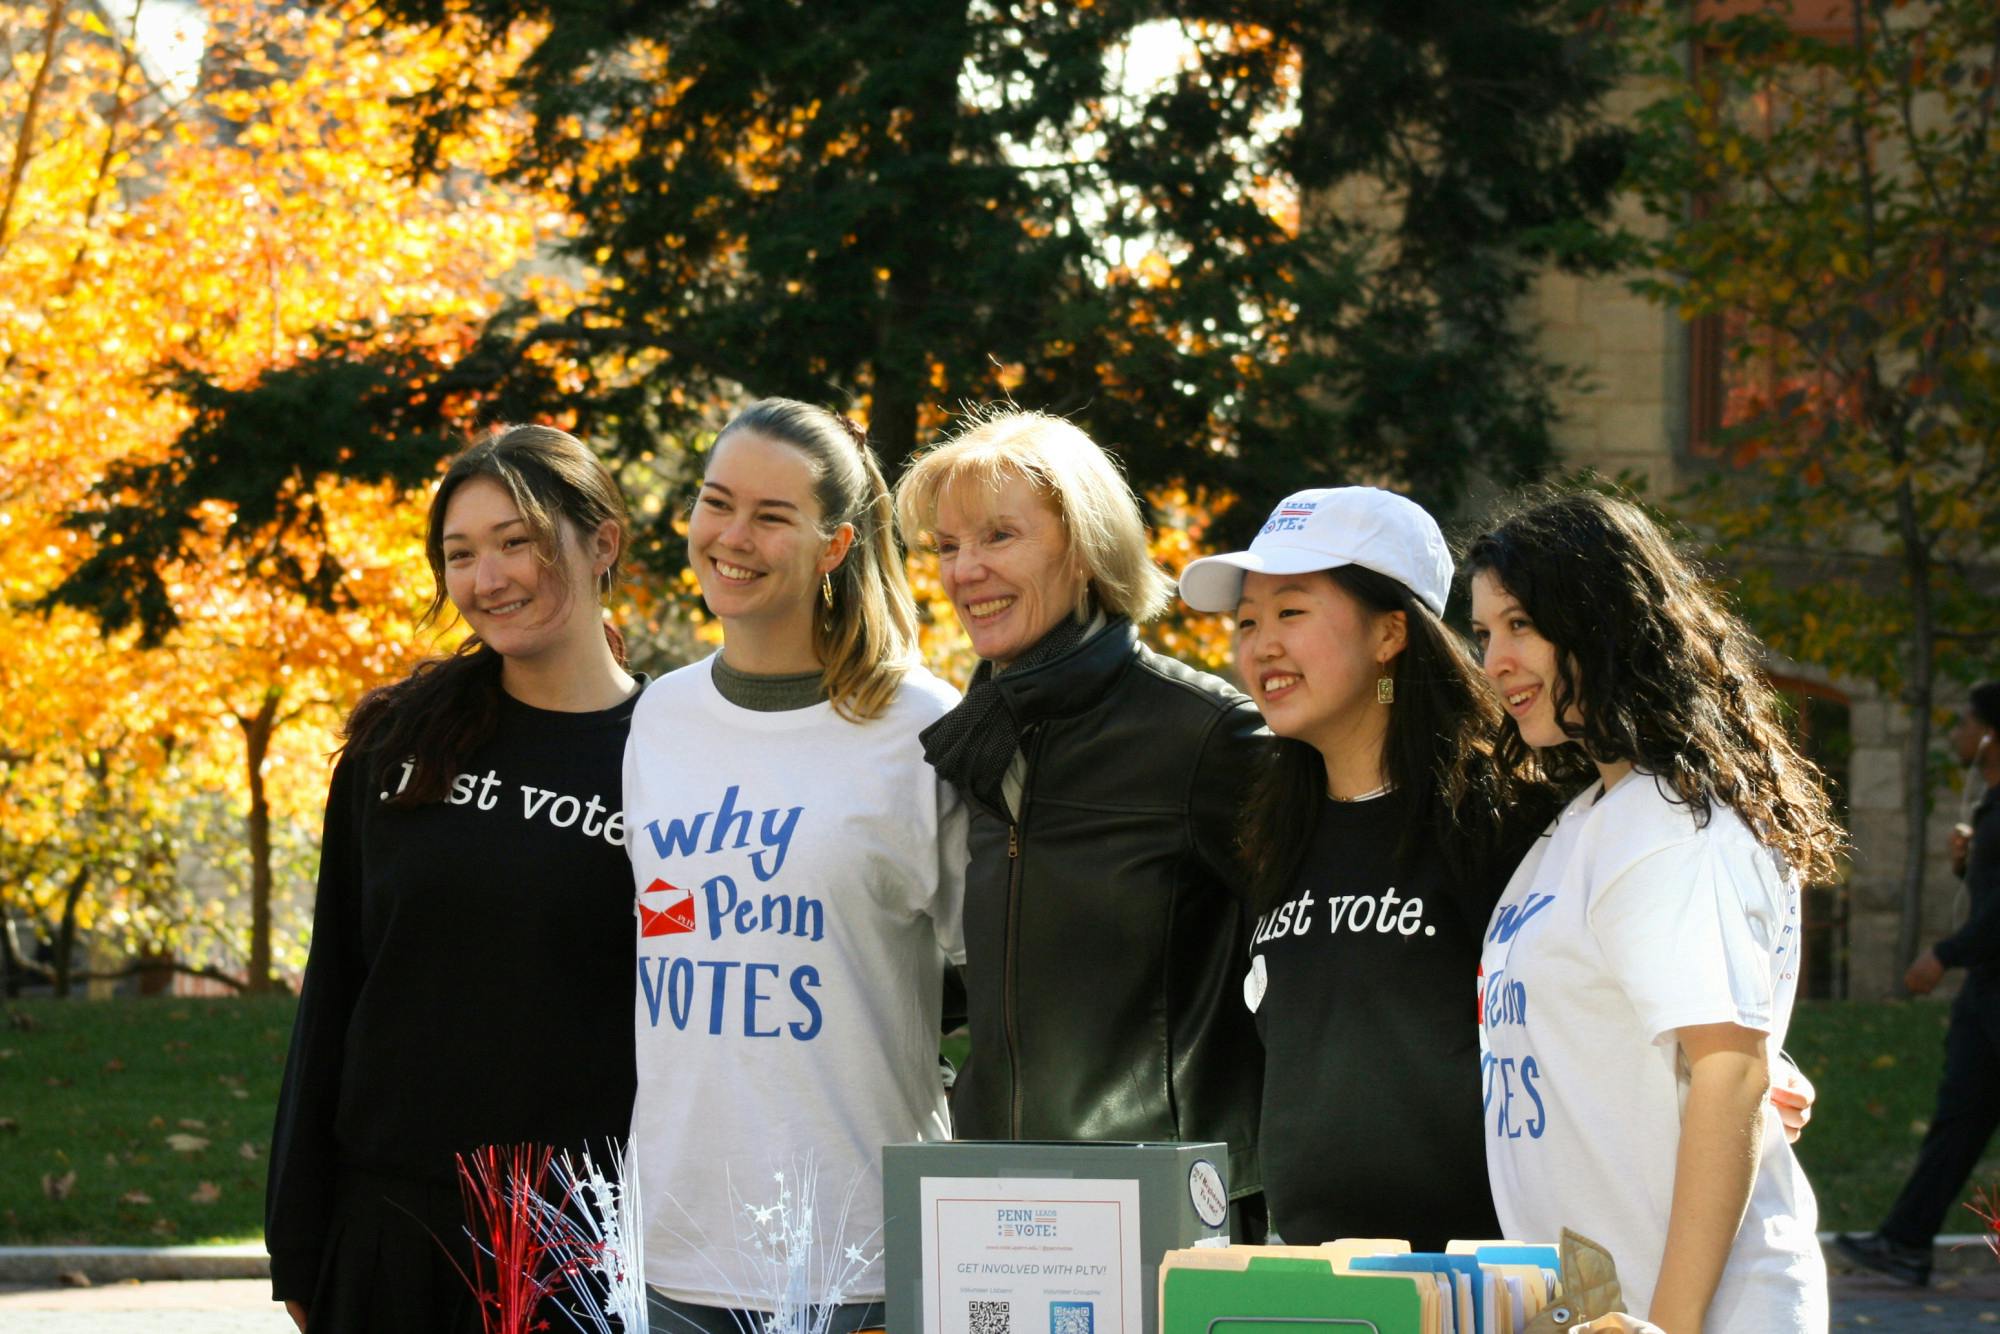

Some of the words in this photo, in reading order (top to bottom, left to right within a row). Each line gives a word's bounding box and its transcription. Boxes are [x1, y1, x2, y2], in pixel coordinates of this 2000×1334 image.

[380, 754, 502, 811] jst
[643, 785, 805, 882] why
[701, 875, 825, 942] Penn
[1328, 887, 1436, 937] vote.
[638, 956, 823, 1041] VOTES
[997, 1209, 1033, 1222] PENN
[957, 1263, 978, 1273] GET
[981, 1263, 1040, 1275] INVOLVED
[1042, 1265, 1073, 1275] WITH
[1075, 1265, 1107, 1276] PLTV!
